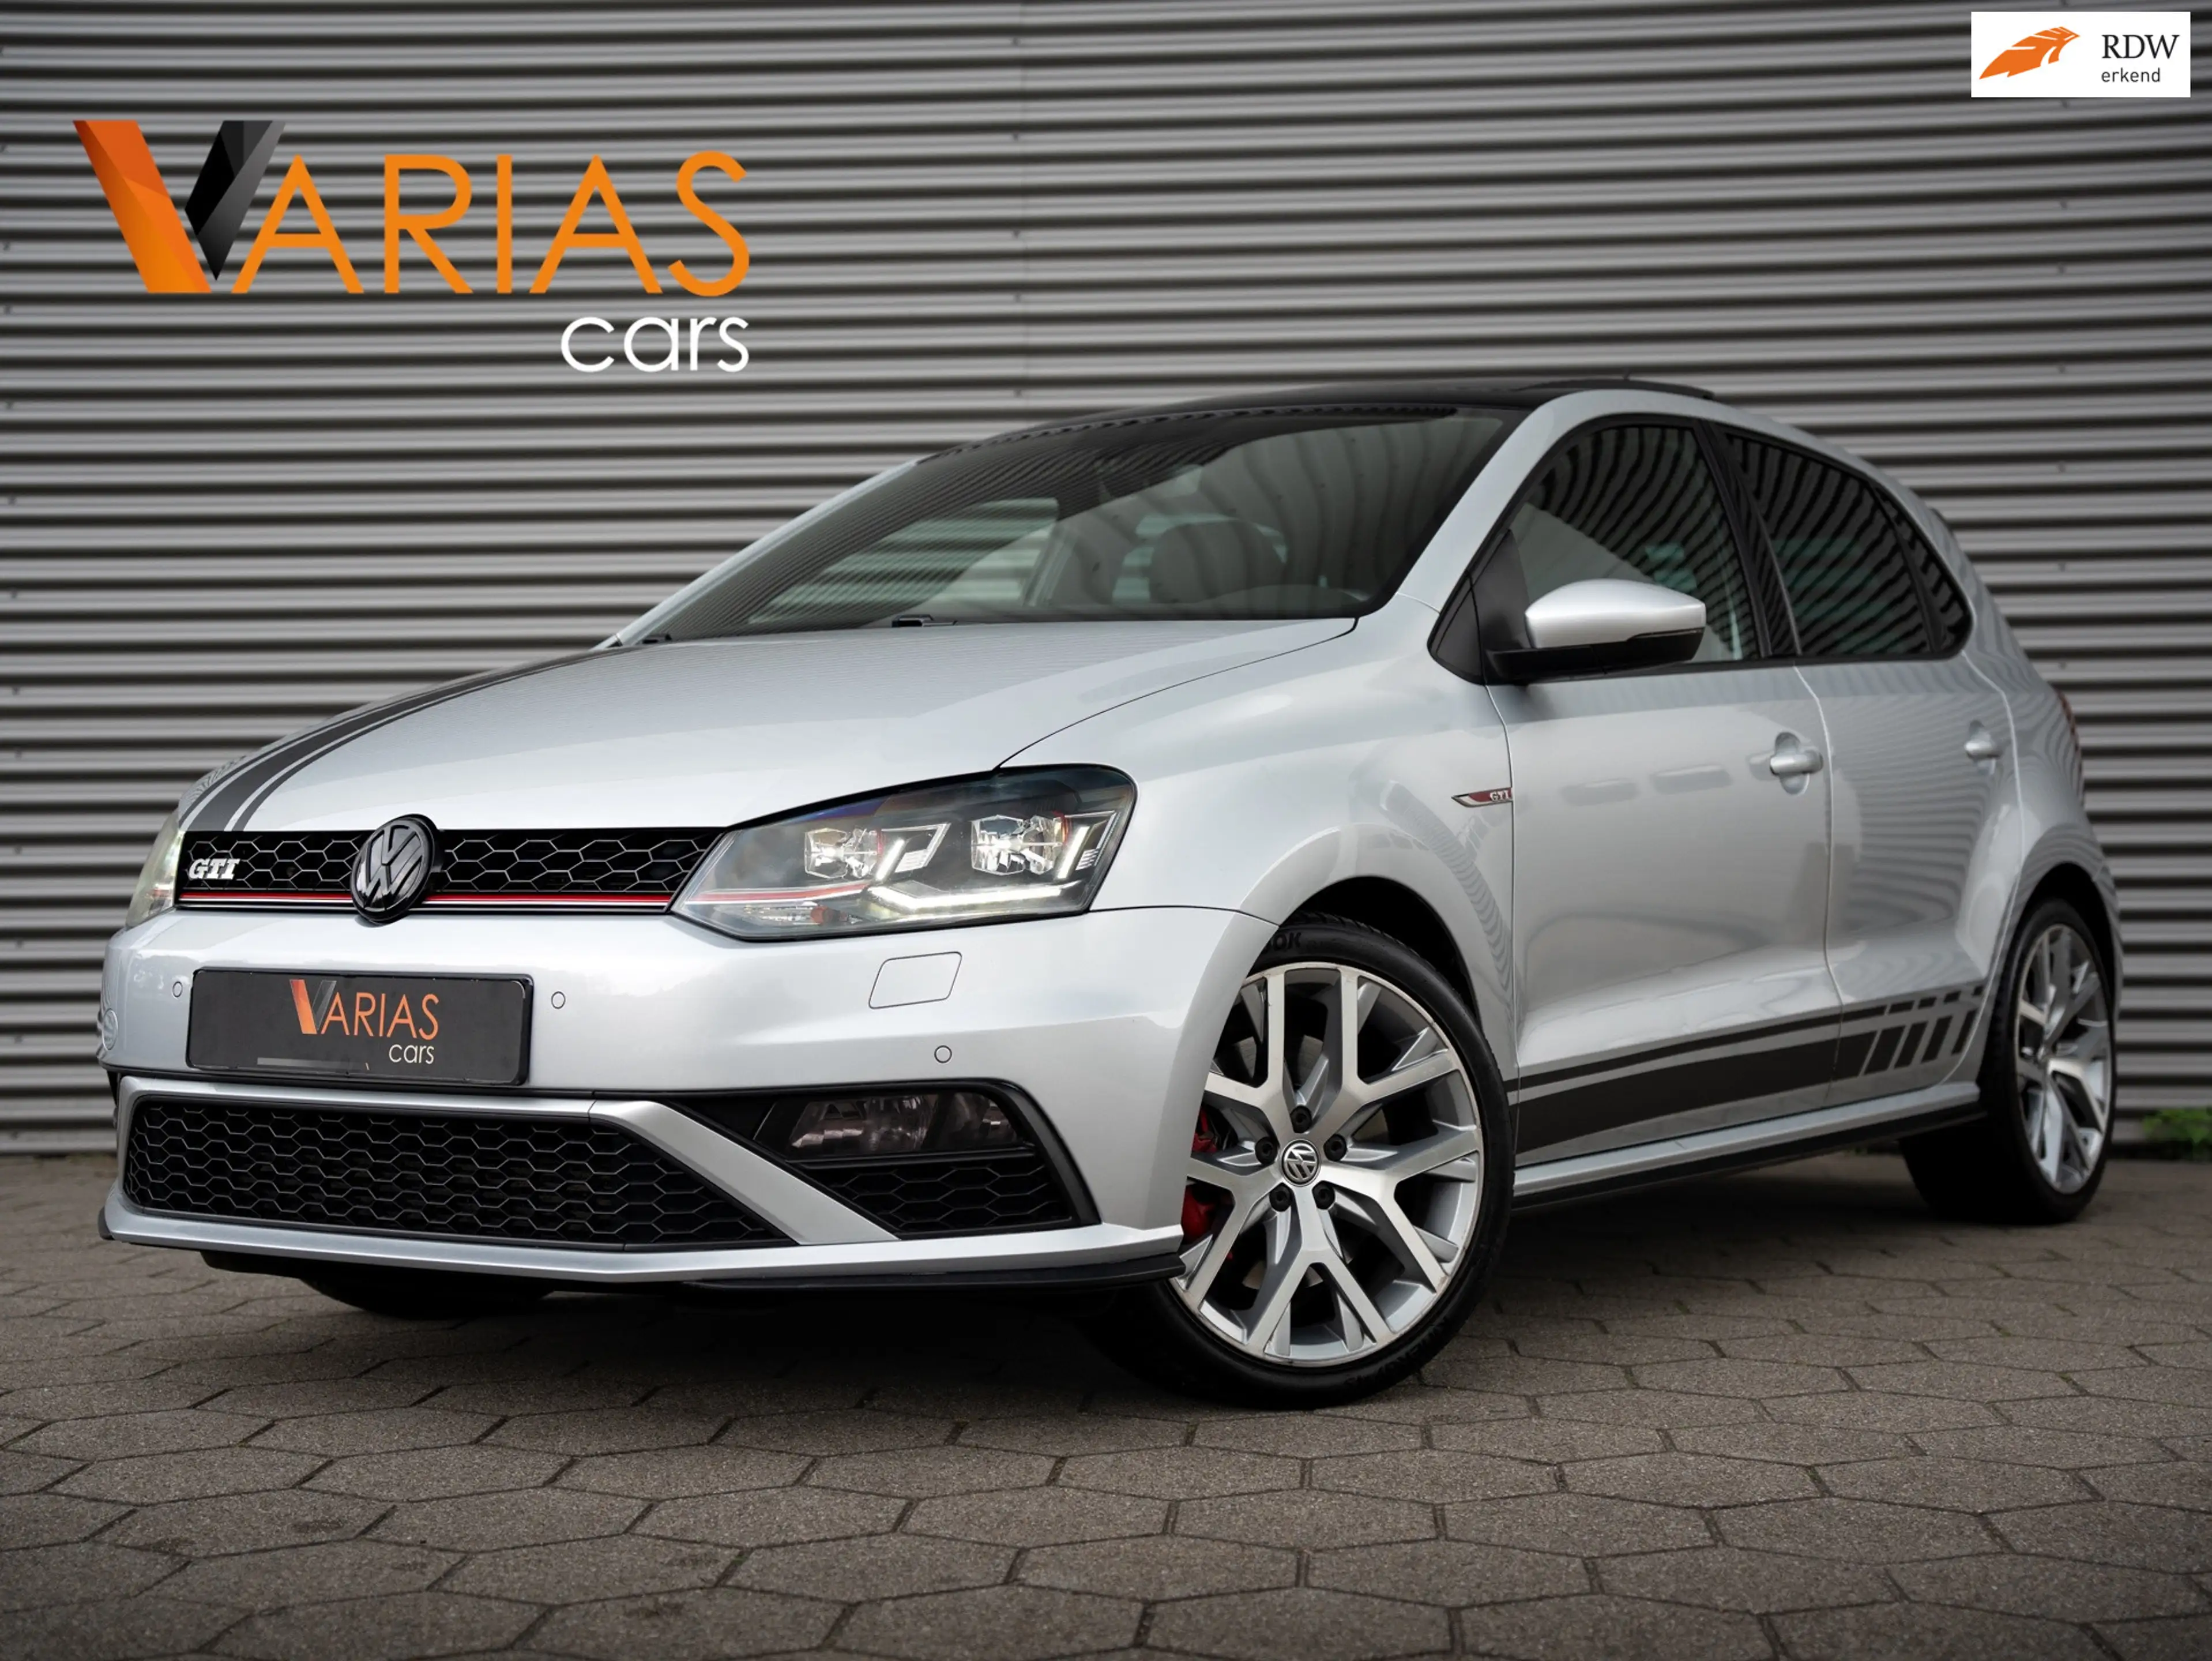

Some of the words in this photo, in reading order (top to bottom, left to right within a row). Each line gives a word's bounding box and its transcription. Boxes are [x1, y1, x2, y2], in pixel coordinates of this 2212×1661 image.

[1489, 790, 1510, 802] GTI
[189, 858, 241, 880] GTI
[289, 979, 440, 1041] VARIAS
[388, 1043, 435, 1065] cars
